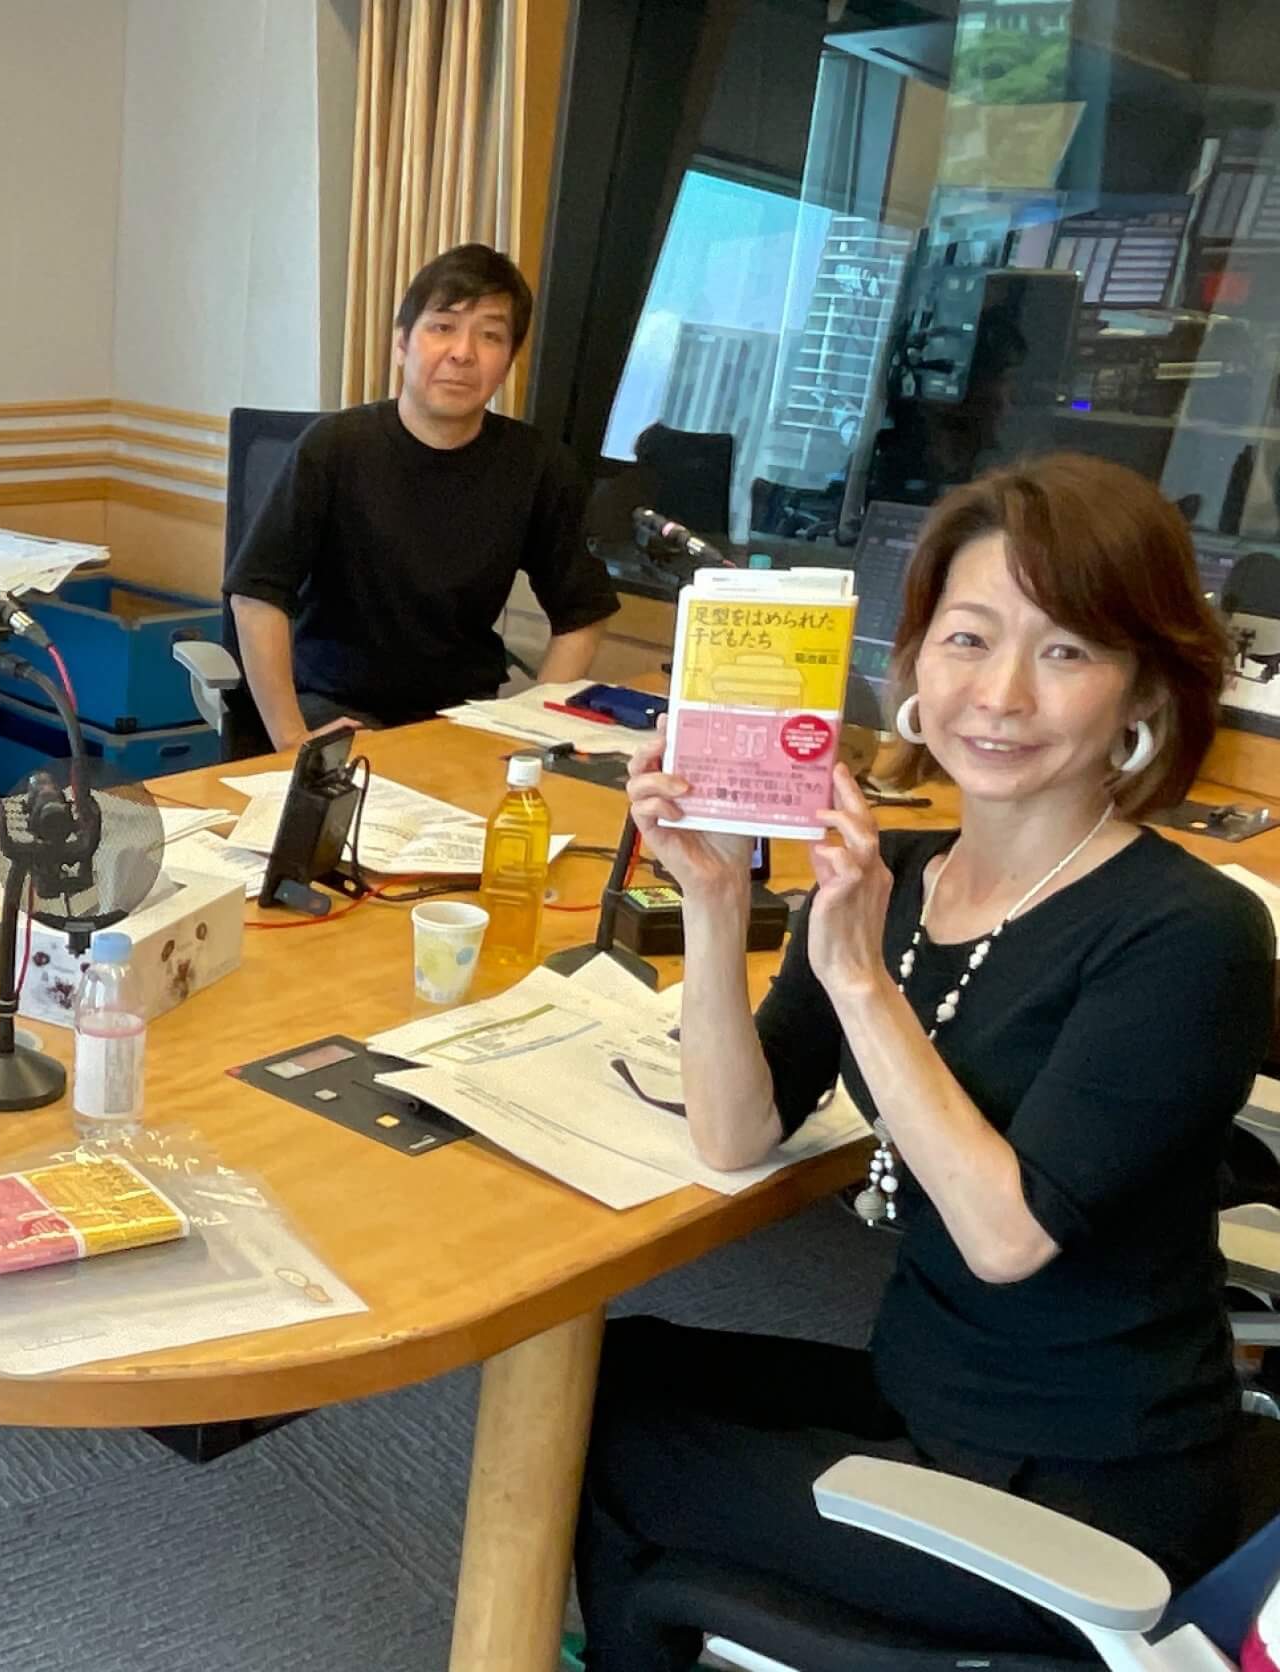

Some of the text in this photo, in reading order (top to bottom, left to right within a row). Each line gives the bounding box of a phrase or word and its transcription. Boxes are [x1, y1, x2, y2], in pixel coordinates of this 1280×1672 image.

[695, 607, 836, 631] 足型をはめられた
[688, 630, 772, 649] 子どもたち
